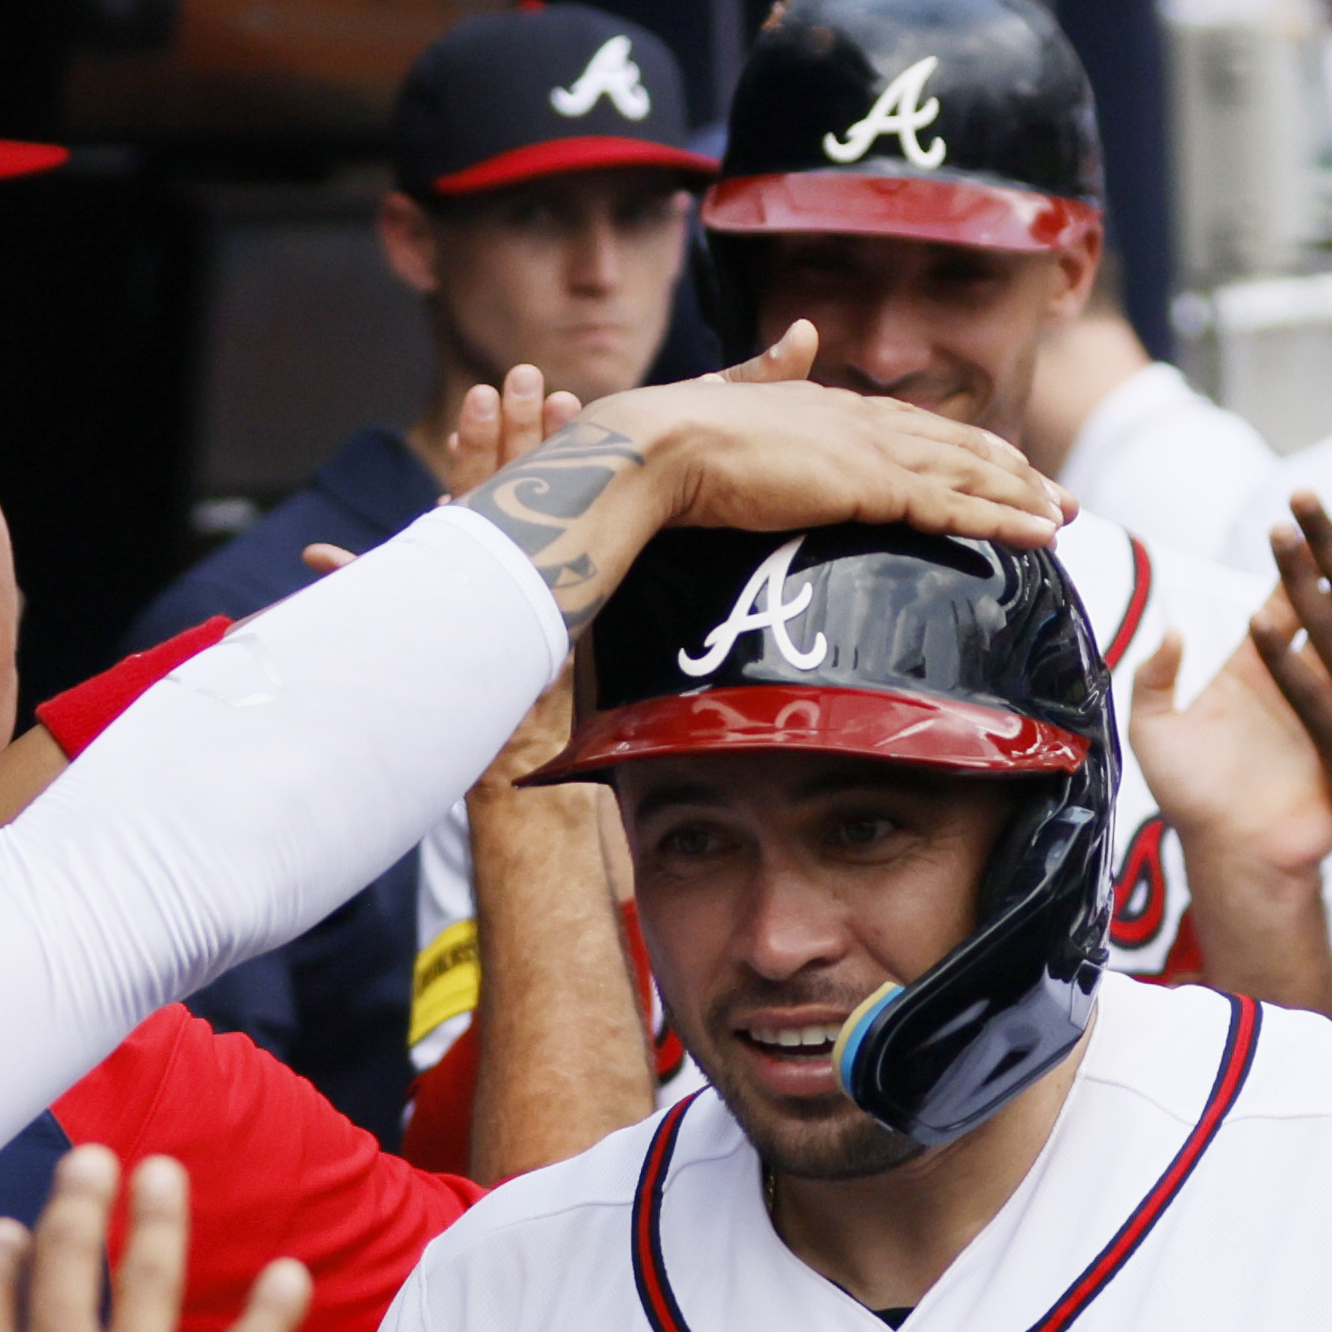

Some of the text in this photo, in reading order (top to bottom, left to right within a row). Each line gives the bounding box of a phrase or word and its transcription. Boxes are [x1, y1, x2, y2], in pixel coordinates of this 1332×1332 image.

[550, 35, 650, 121] A
[823, 55, 947, 169] A
[677, 533, 828, 678] A
